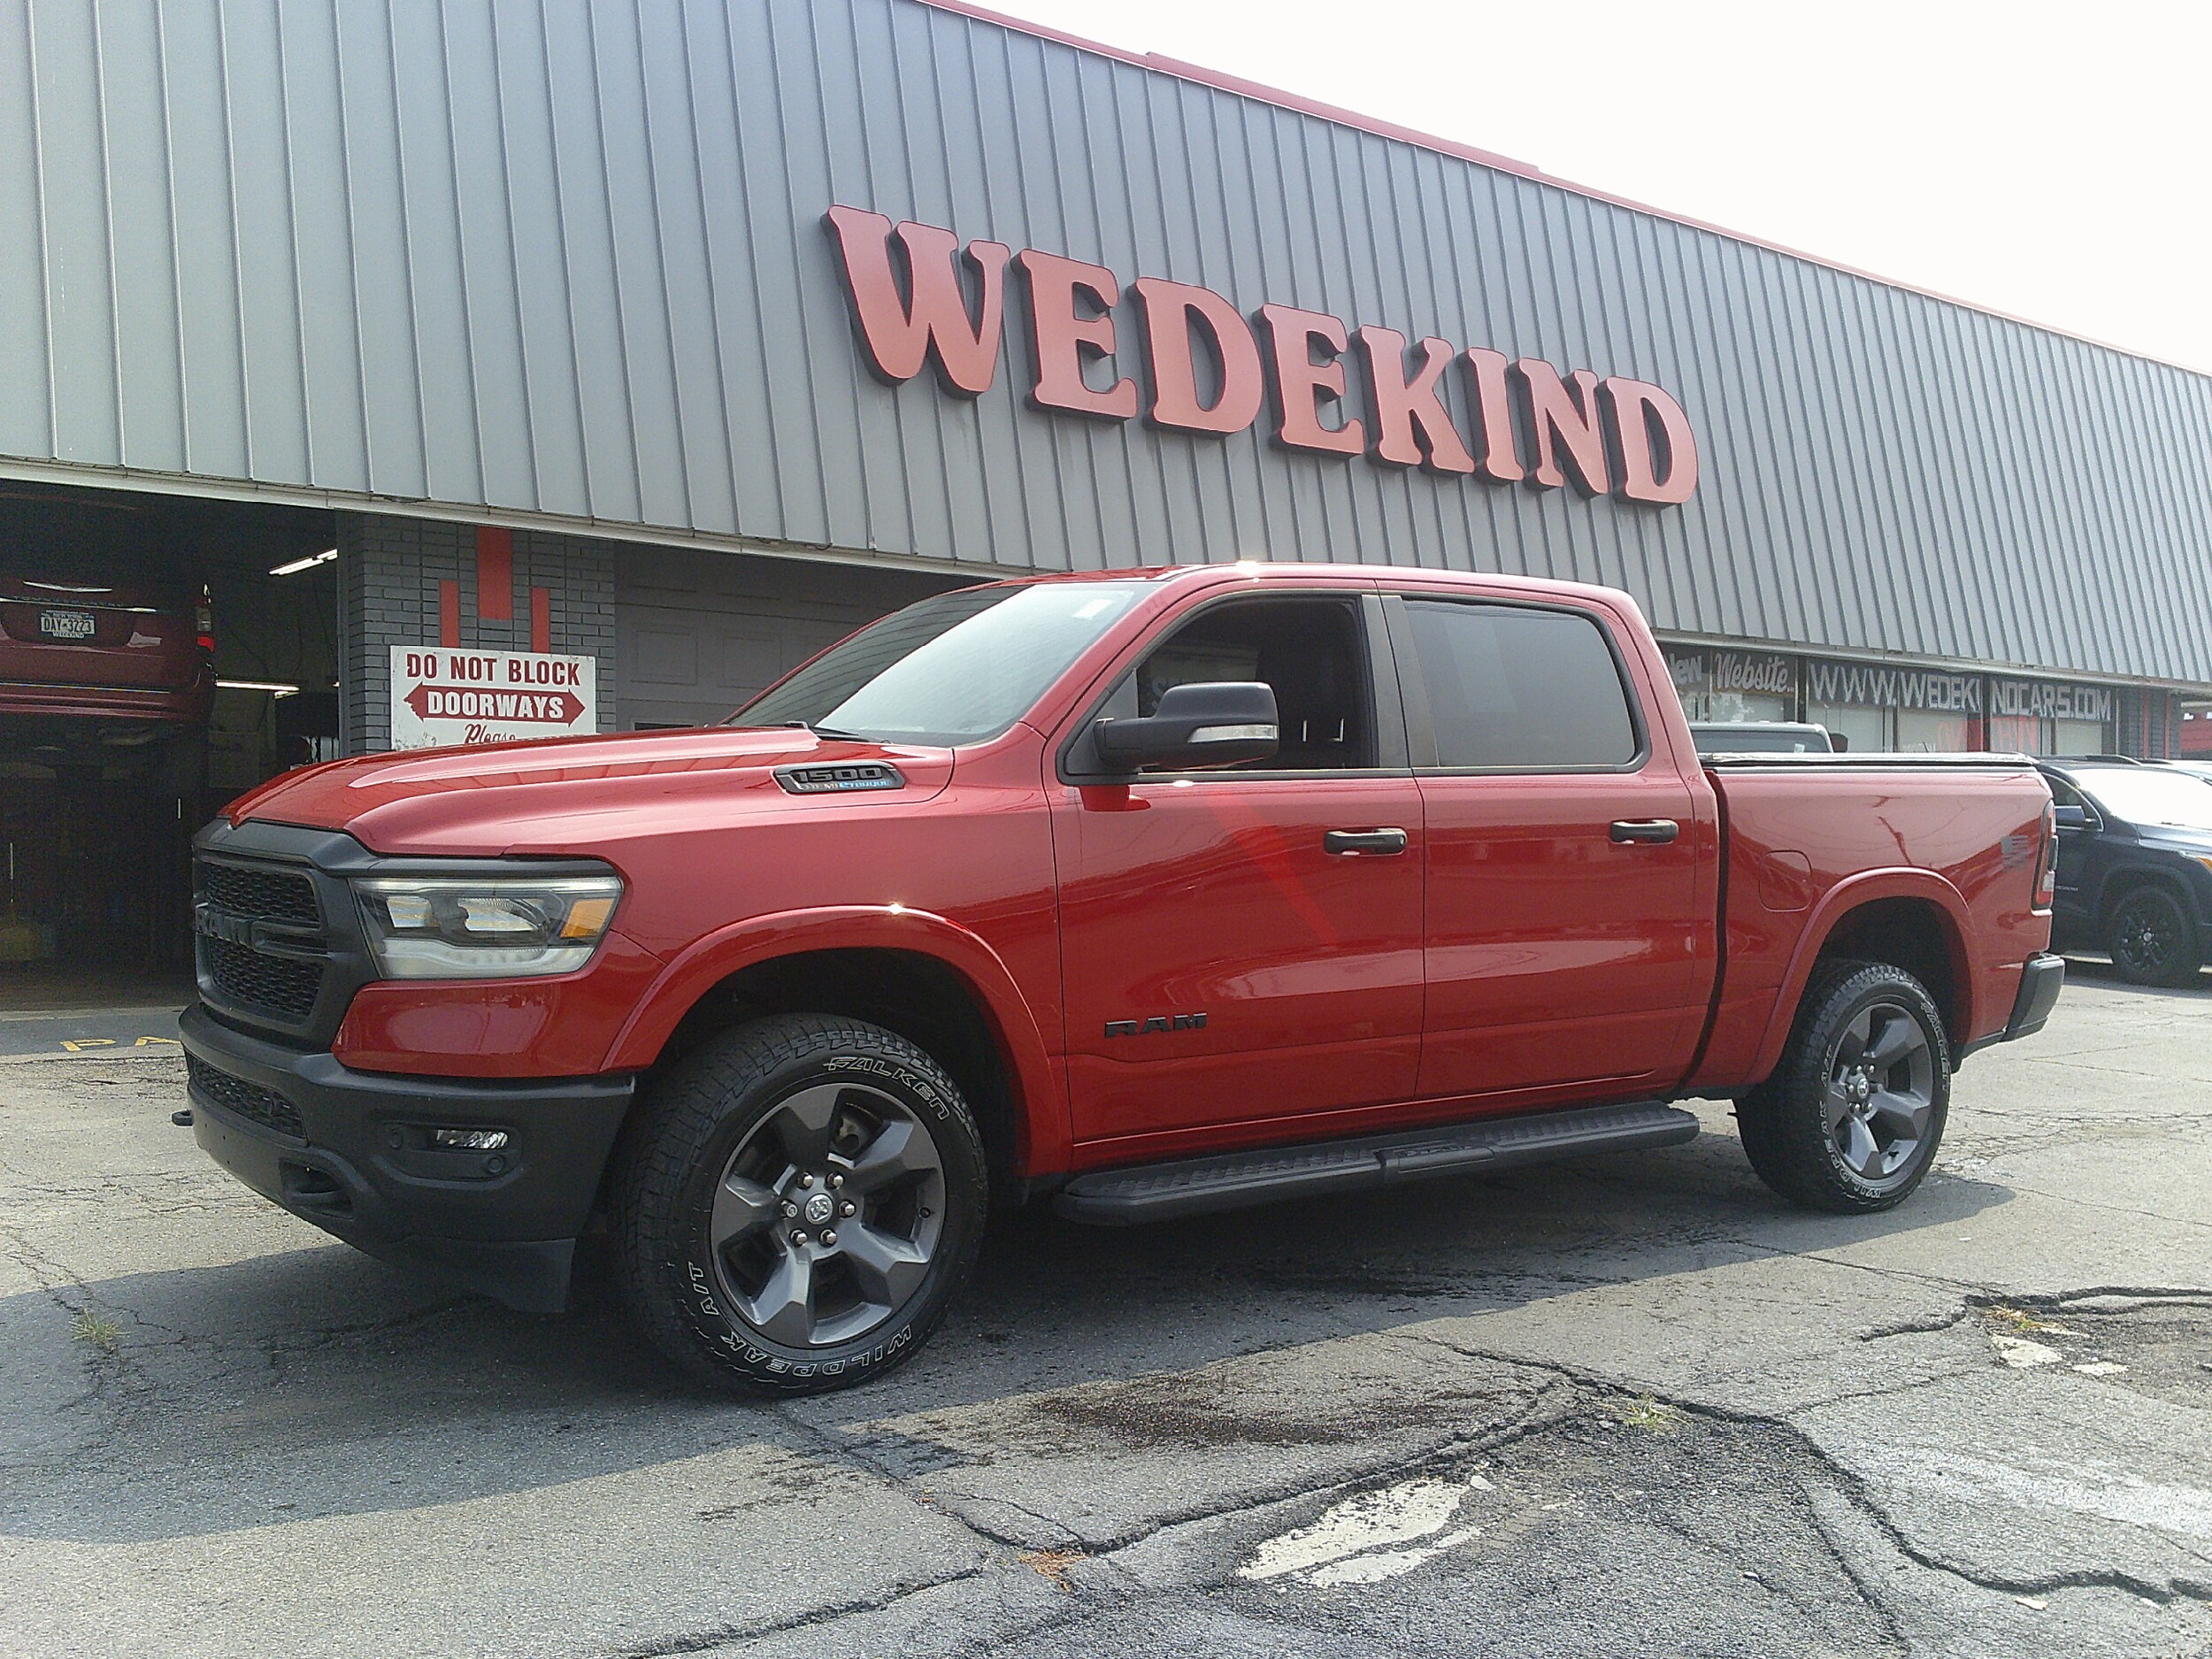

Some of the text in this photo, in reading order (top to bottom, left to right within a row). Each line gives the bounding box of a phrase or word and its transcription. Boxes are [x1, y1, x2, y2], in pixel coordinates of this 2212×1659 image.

[821, 204, 1699, 506] WEDEKIND
[406, 653, 580, 686] DO NOT BLOCK
[427, 691, 565, 718] DOORWAYS
[797, 767, 883, 782] 1500
[1104, 1012, 1207, 1038] RAM
[824, 1056, 951, 1121] FALKEN
[688, 1262, 911, 1377] WILDPEAK A/T
